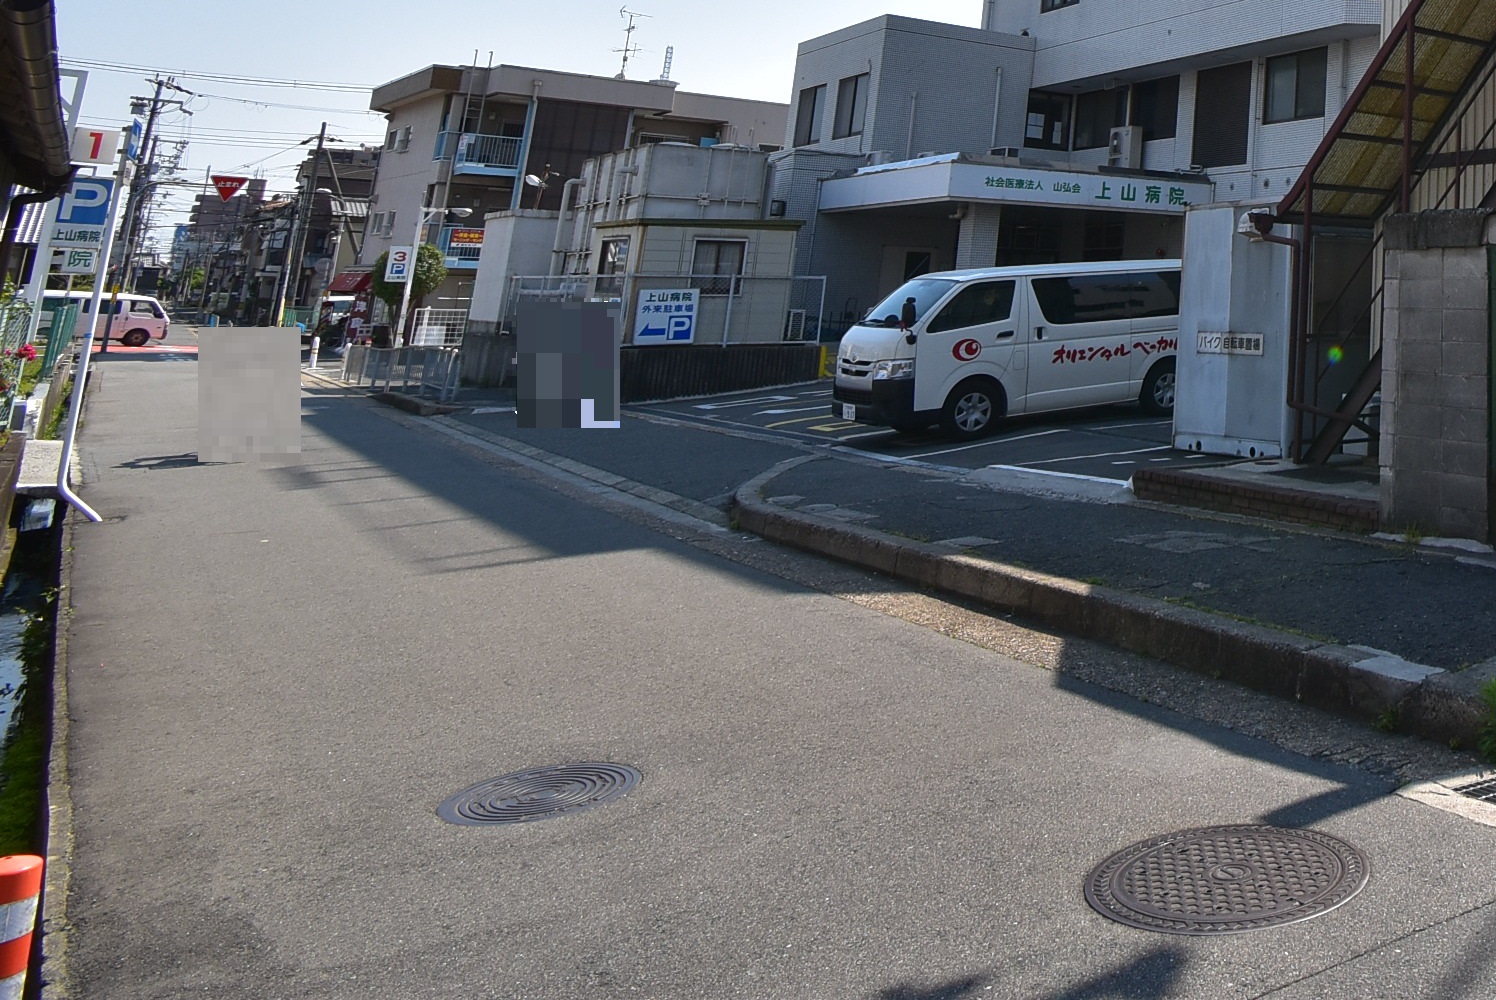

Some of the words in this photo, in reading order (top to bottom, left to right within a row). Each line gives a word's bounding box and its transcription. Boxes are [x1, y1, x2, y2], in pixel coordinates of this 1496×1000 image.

[89, 131, 104, 160] 1
[984, 175, 1044, 191] 社会医療法人
[1052, 181, 1082, 194] 山弘会
[1095, 181, 1186, 206] 上山病院
[59, 182, 109, 220] P
[52, 229, 101, 243] 上山病院
[393, 251, 407, 262] 3
[392, 264, 404, 274] P
[645, 292, 693, 303] 上山病院
[641, 304, 694, 314] 外来駐車場
[668, 317, 691, 340] P
[1199, 336, 1221, 349] バイク
[1051, 344, 1132, 364] オリエンタル
